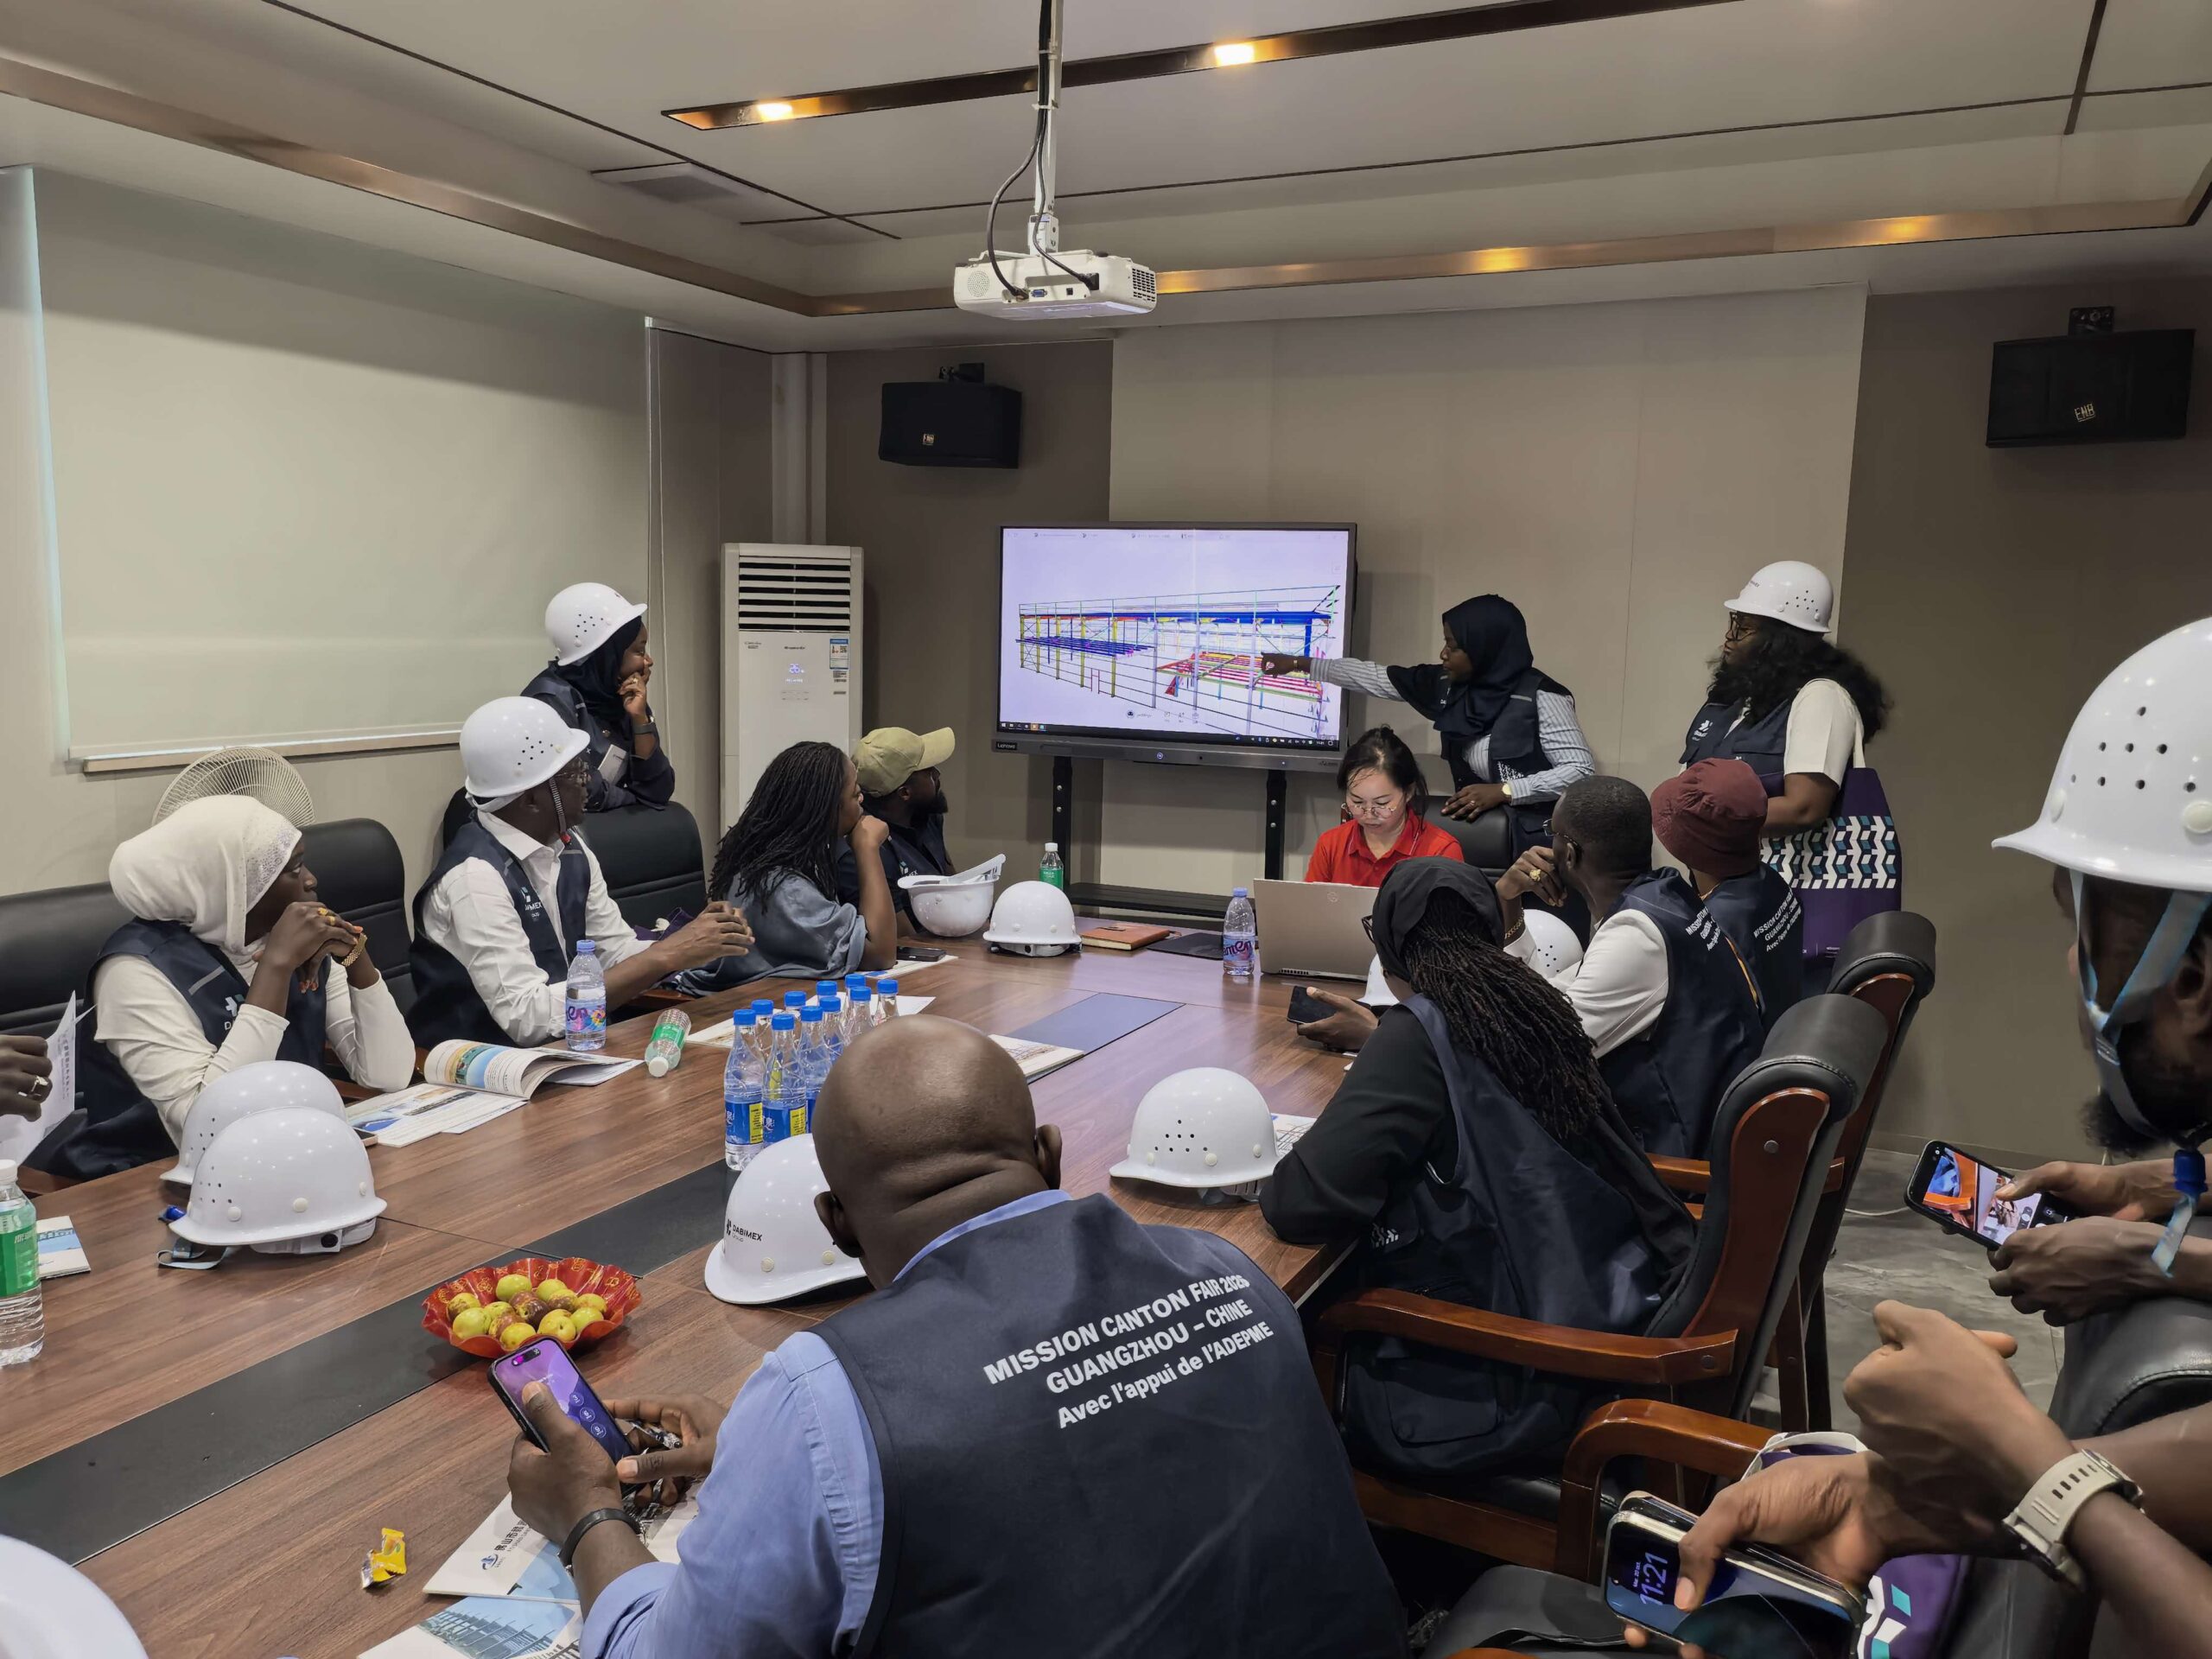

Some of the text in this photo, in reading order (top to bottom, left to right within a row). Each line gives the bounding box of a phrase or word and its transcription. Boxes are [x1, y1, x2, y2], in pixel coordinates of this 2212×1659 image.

[732, 1224, 762, 1242] DABIMEX
[983, 1322, 1100, 1384] MISSION
[1101, 1288, 1191, 1338] CANTON
[1188, 1279, 1224, 1302] FAIR
[1046, 1322, 1189, 1393] GUANGZHOU
[1205, 1299, 1253, 1328] CHINE
[1058, 1321, 1274, 1429] Avec l'appui de l'ADEPME
[1639, 1552, 1669, 1606] 11:21
